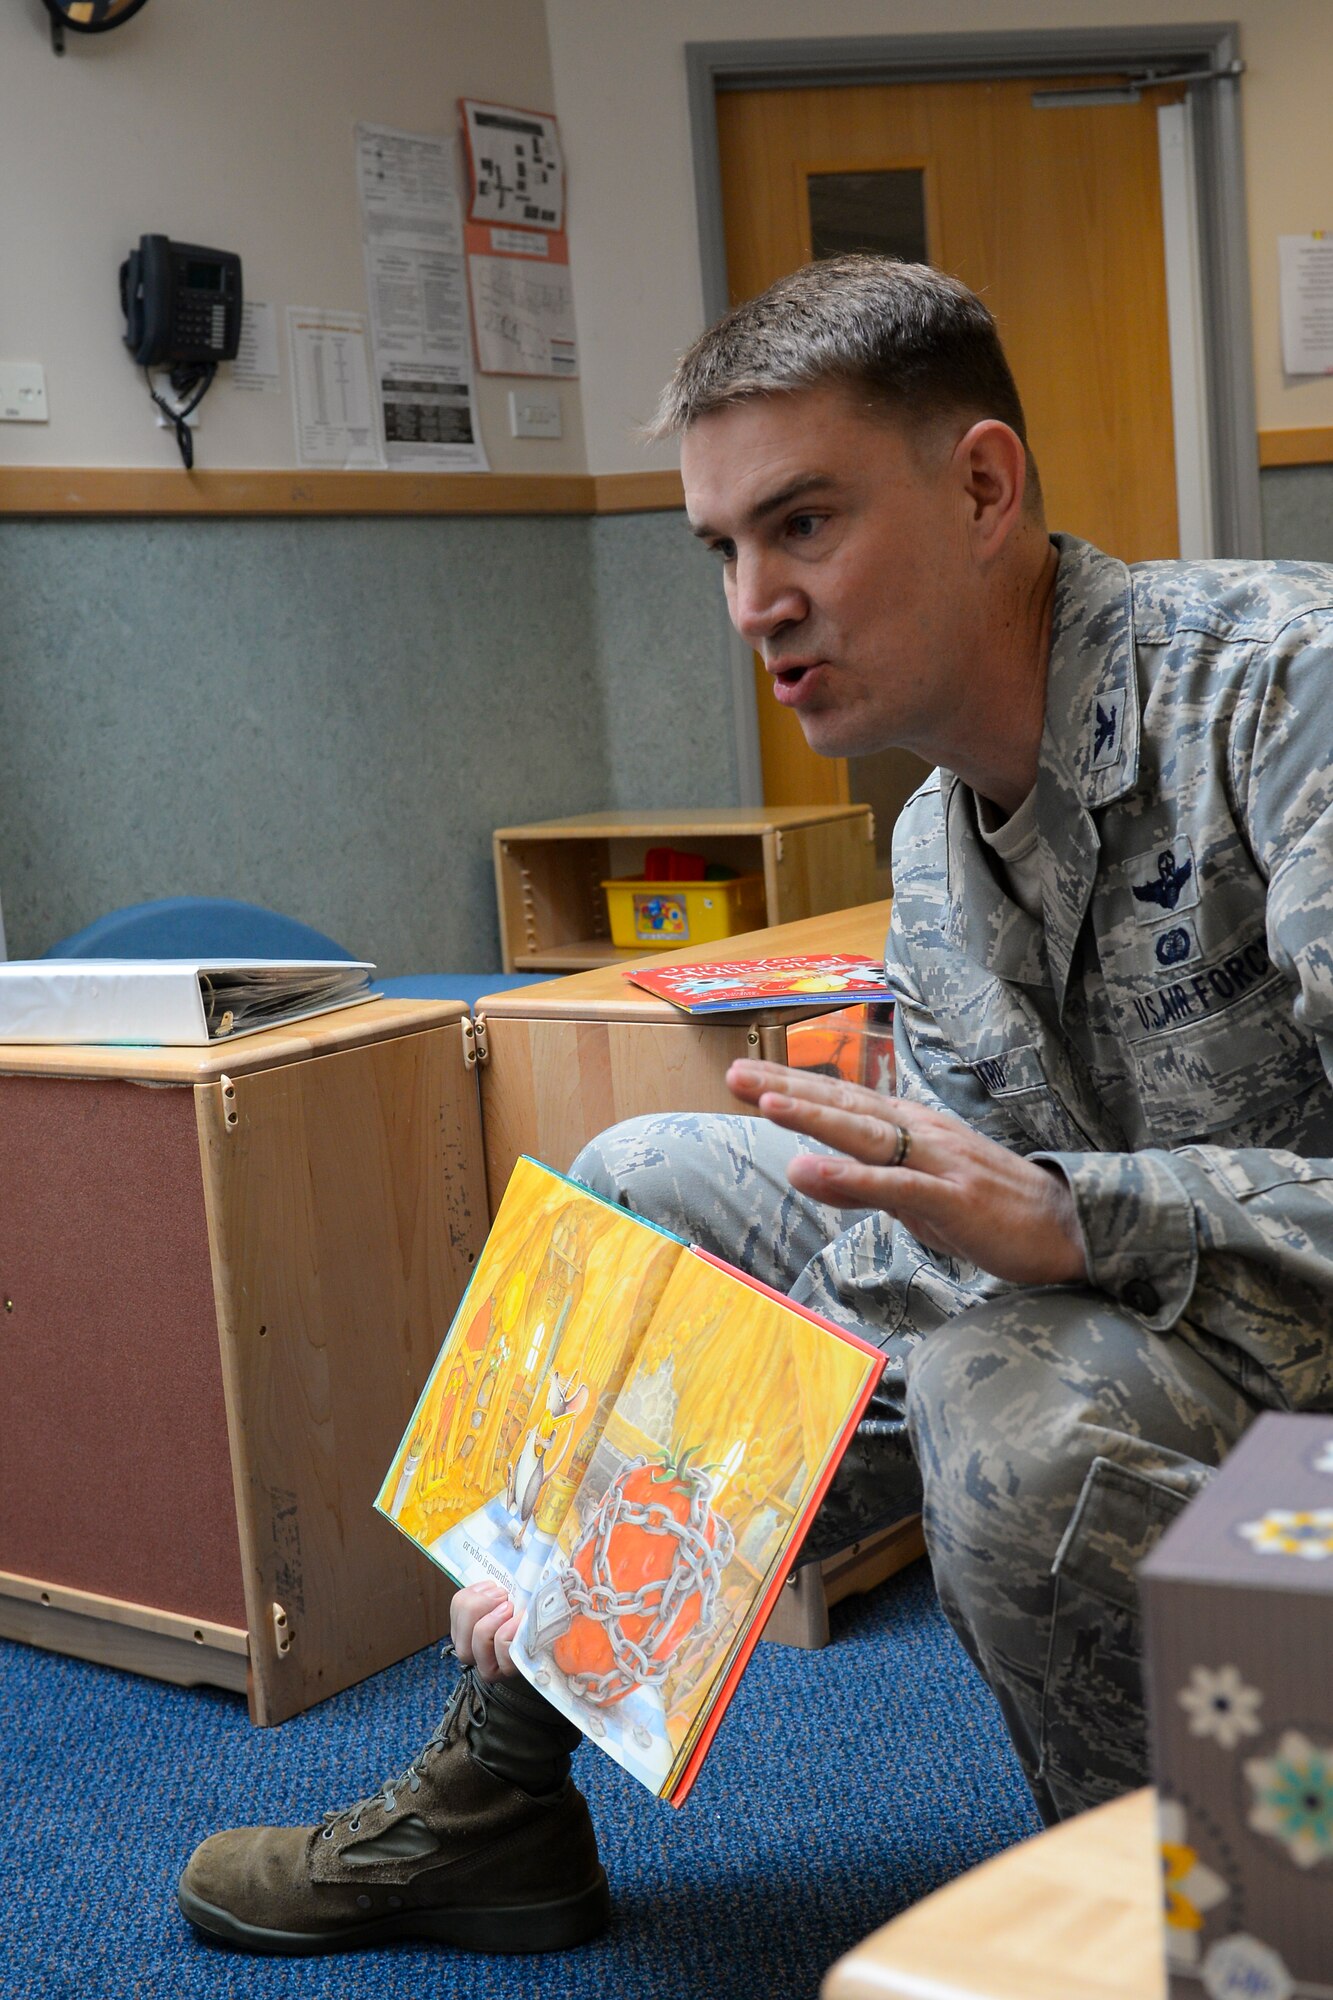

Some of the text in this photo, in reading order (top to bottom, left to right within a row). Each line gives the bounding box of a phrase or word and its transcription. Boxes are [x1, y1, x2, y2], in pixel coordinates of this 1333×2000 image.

[663, 963, 720, 974] Join
[750, 956, 807, 965] Zoo
[1158, 983, 1193, 1025] AIR
[1190, 934, 1269, 1009] FORC
[463, 1540, 471, 1551] or
[470, 1546, 483, 1563] who
[481, 1555, 489, 1569] is
[487, 1563, 513, 1592] guarding
